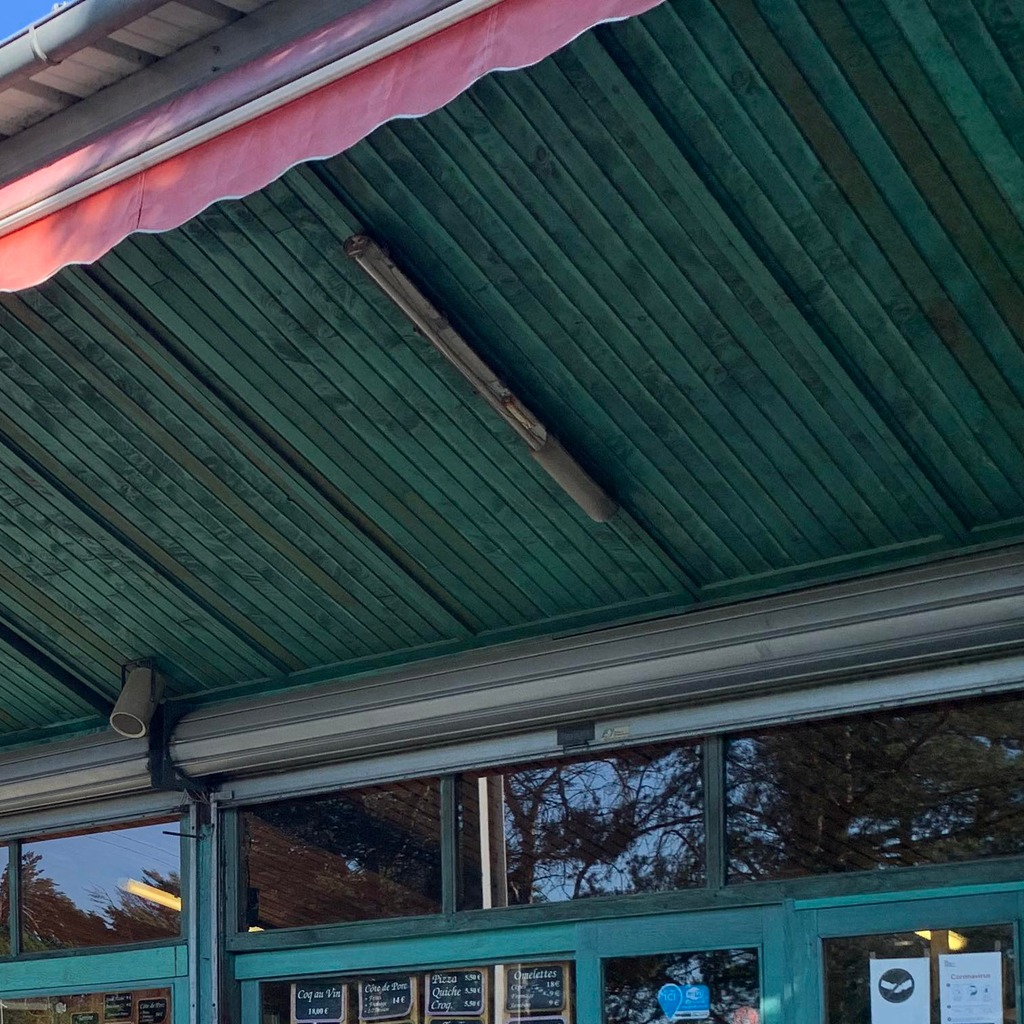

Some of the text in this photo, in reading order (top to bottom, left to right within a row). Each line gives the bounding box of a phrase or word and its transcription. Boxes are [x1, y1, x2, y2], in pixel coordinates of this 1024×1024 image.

[432, 973, 457, 984] Pizza
[950, 973, 991, 981] Coronavirus
[381, 981, 390, 992] de
[391, 981, 408, 991] Porc
[432, 985, 462, 999] Quiche
[297, 988, 341, 1003] Coq au Vin
